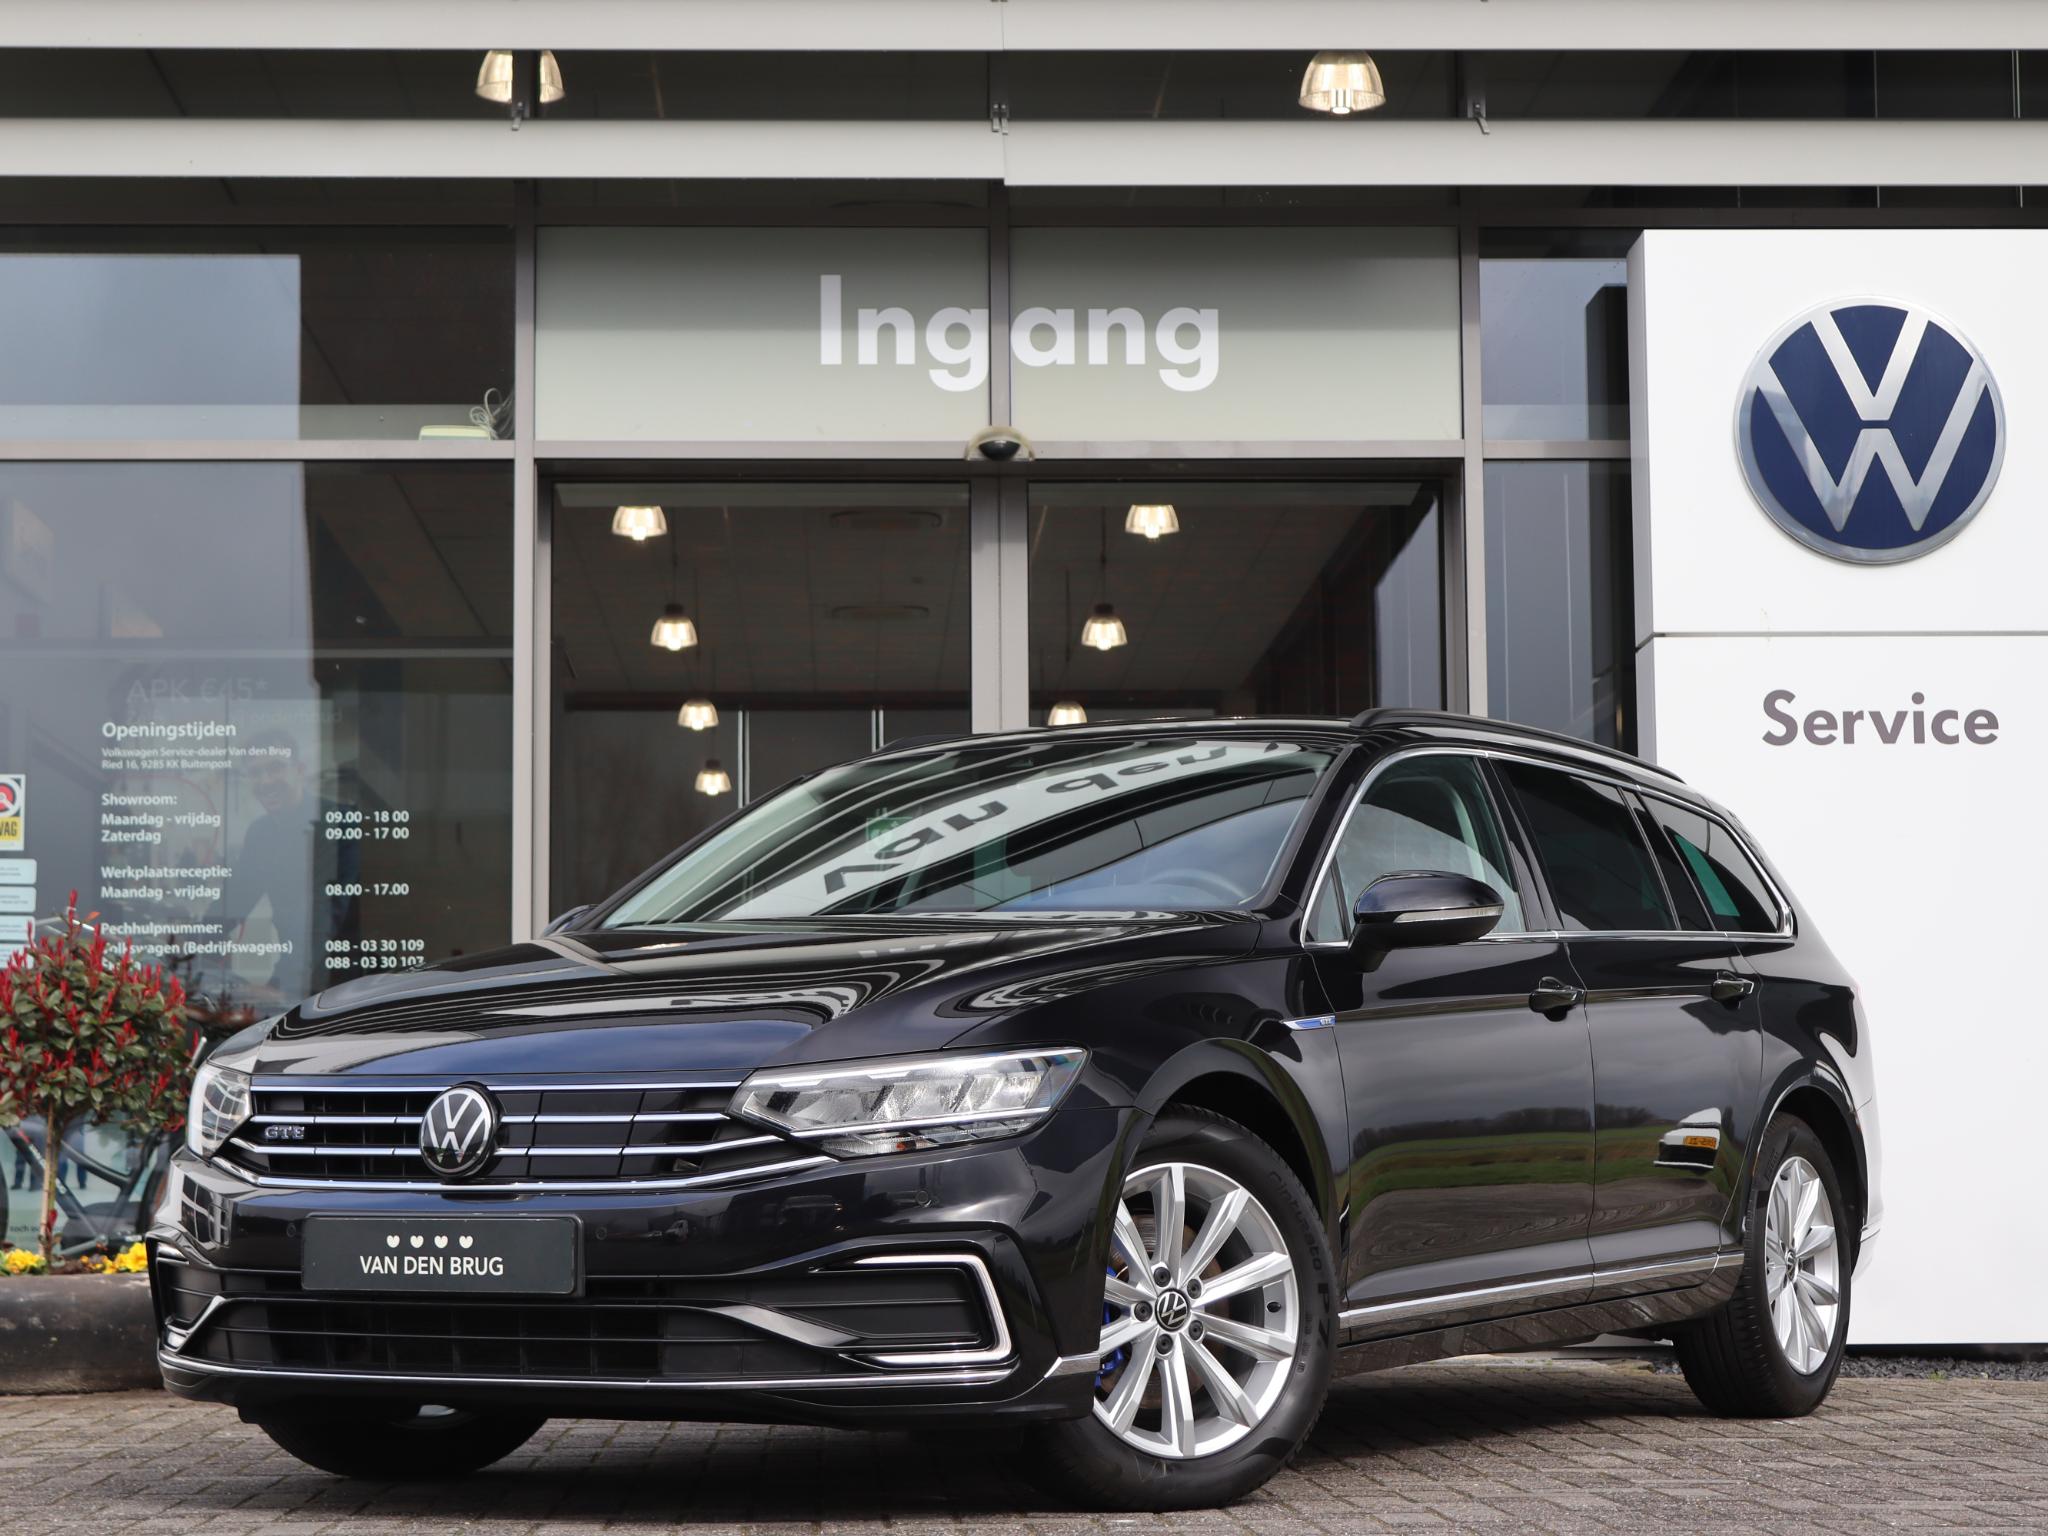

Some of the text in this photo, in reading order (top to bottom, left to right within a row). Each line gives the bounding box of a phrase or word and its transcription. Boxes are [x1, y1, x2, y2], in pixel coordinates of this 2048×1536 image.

[820, 275, 1219, 392] Ingang
[1748, 302, 1996, 533] VW
[127, 678, 191, 703] APK
[1761, 689, 2000, 746] Service
[102, 720, 237, 741] Openingstijden
[102, 746, 292, 759] Volkswagen Service-dealer Van den Brug
[102, 759, 123, 769] Ried
[166, 759, 179, 769] KK
[181, 759, 232, 770] Buitenpost
[102, 794, 177, 806] Showroom:
[101, 813, 163, 828] Maandag
[175, 813, 221, 828] vrijdag
[325, 811, 362, 823] 09.00
[101, 829, 162, 844] Zaterdag
[325, 828, 362, 839] 09.00
[101, 864, 232, 880] Werkplaatsreceptie:
[101, 885, 163, 900] Maandag
[174, 885, 221, 900] vrijdag
[325, 884, 362, 896] 08.00
[373, 883, 409, 895] 17.00
[101, 921, 223, 937] Pechhulpnummer:
[102, 940, 293, 957] olkswagen (Bedrijfswagens)
[325, 940, 350, 952] 088
[360, 940, 377, 952] 03
[380, 940, 397, 952] 30
[400, 939, 424, 951] 109
[325, 957, 350, 969] 088
[360, 957, 377, 969] 03
[380, 957, 397, 969] 30
[264, 1124, 305, 1140] GTE
[423, 1090, 488, 1166] VW
[359, 1255, 504, 1276] VAN DEN BRUG
